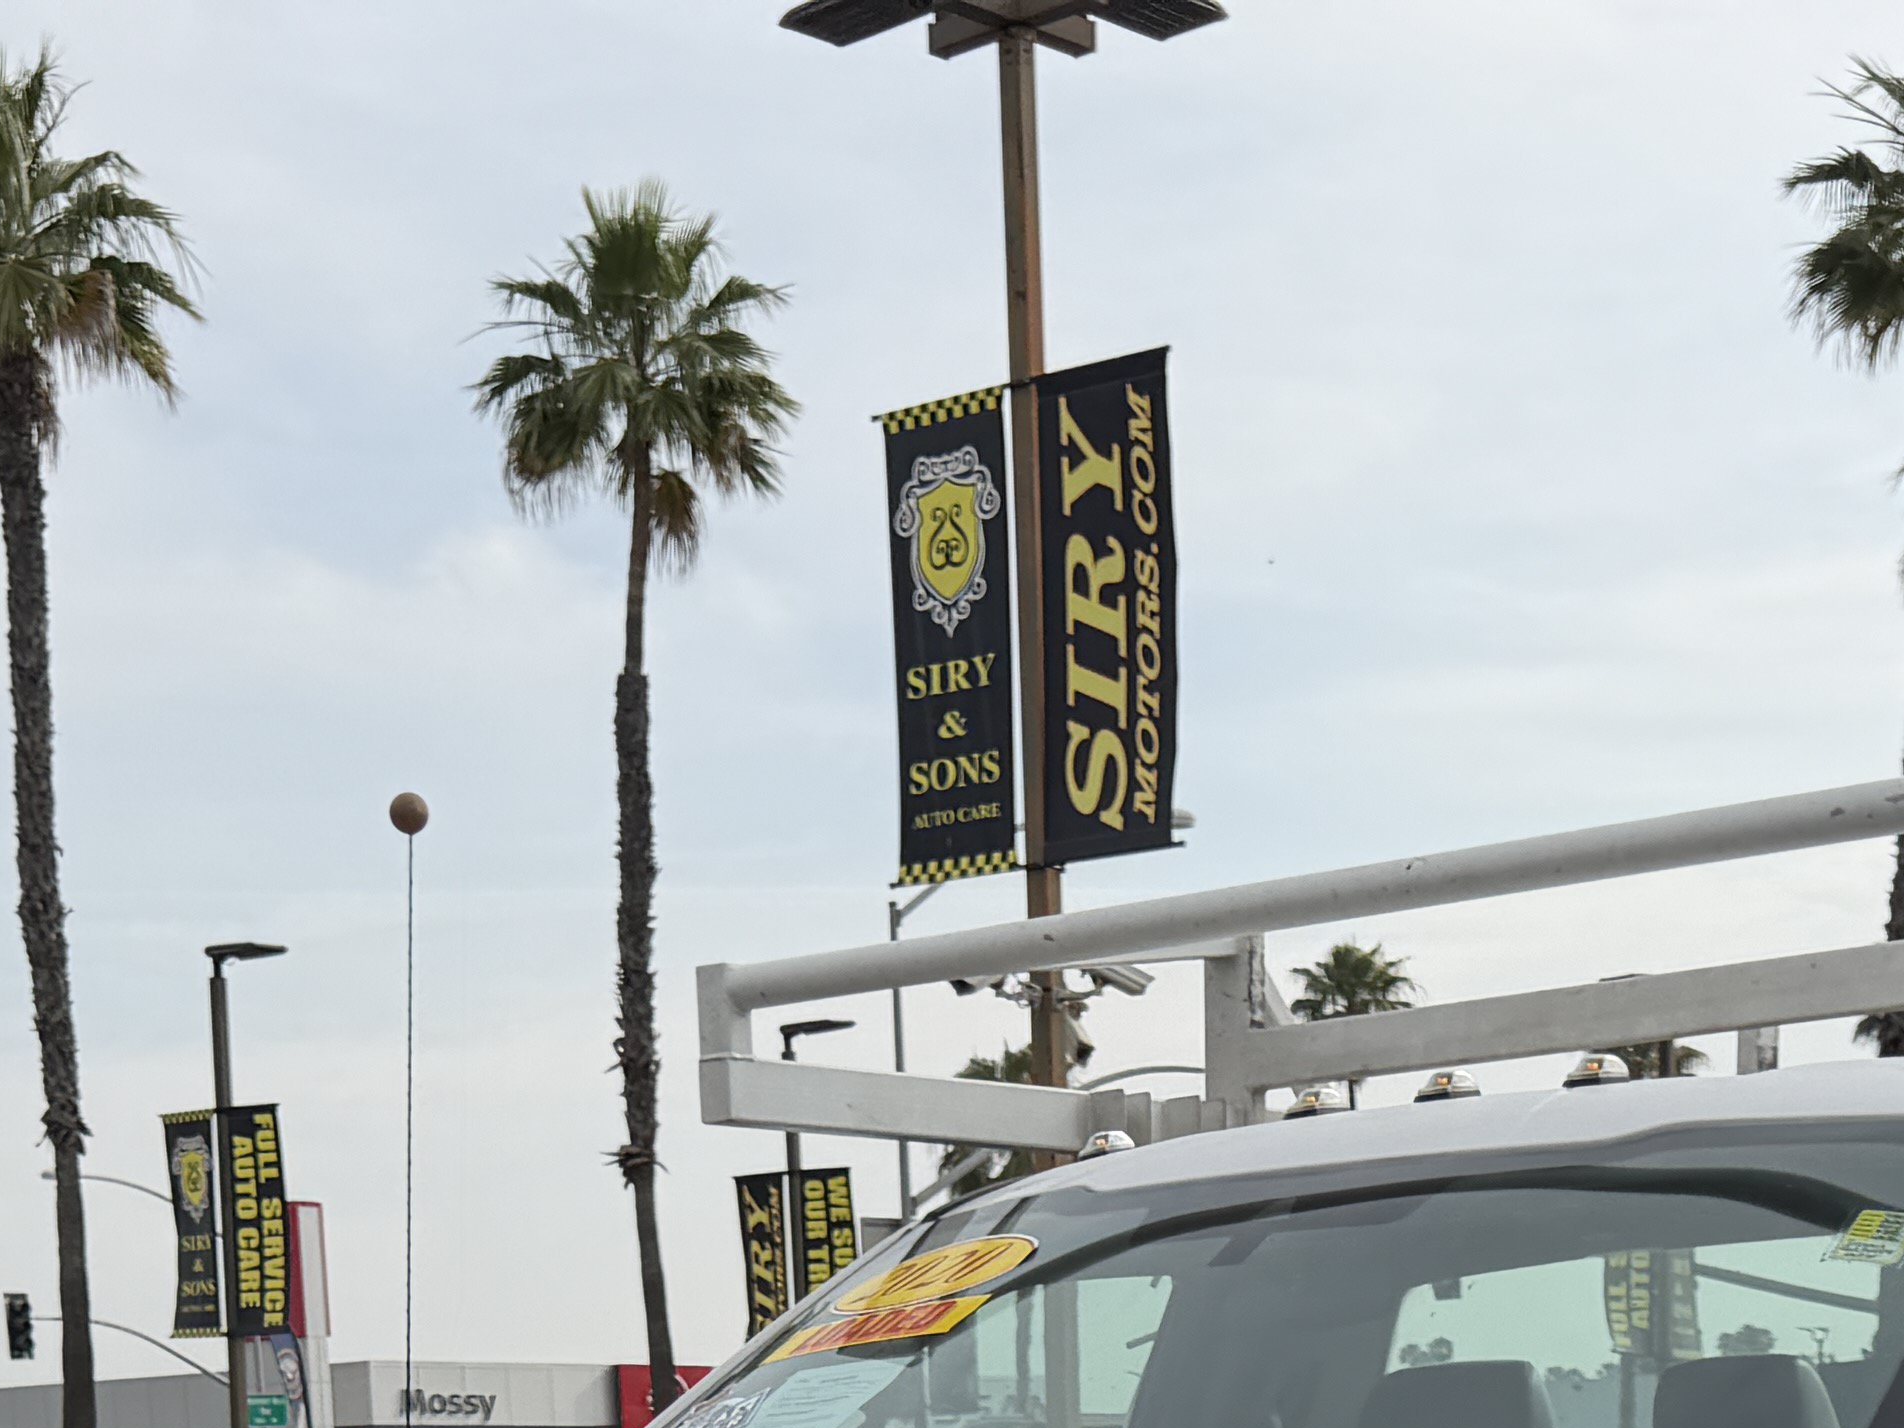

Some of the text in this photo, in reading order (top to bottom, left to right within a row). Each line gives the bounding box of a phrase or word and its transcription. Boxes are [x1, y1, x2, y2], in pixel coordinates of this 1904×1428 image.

[1058, 396, 1129, 831] SIRY
[1124, 383, 1161, 824] MOTORS.COM
[906, 653, 996, 700] SIRY
[937, 711, 968, 739] &
[909, 750, 1001, 795] SONS
[912, 803, 1001, 830] AUTO CARE
[232, 1135, 261, 1309] AUTO CARE
[253, 1113, 286, 1328] FULL SERVICE
[804, 1179, 828, 1240] OUR
[827, 1175, 853, 1223] WE
[181, 1280, 216, 1298] SONS
[399, 1388, 497, 1424] Mossy
